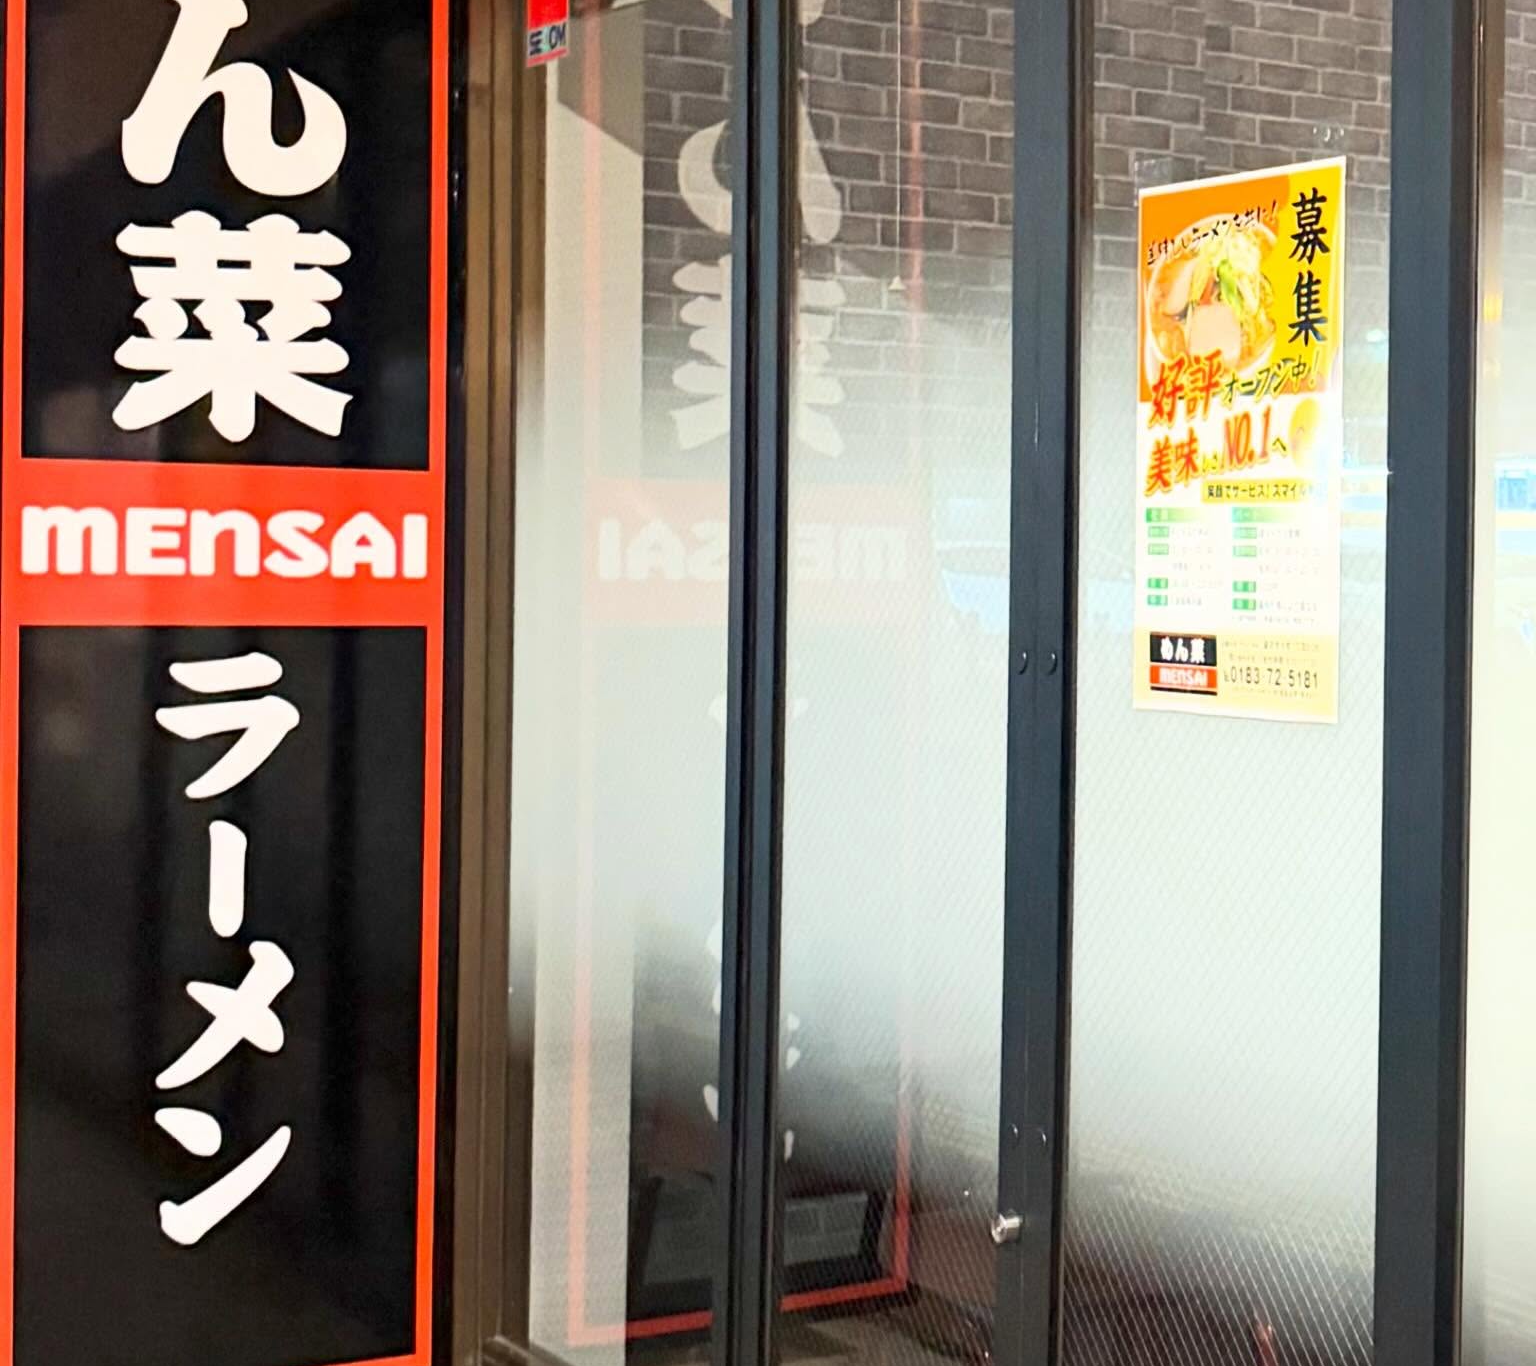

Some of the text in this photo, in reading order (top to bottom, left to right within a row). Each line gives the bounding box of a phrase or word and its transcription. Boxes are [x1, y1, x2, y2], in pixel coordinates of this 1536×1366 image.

[1289, 187, 1331, 347] 募集
[154, 651, 300, 1246] ラーメン
